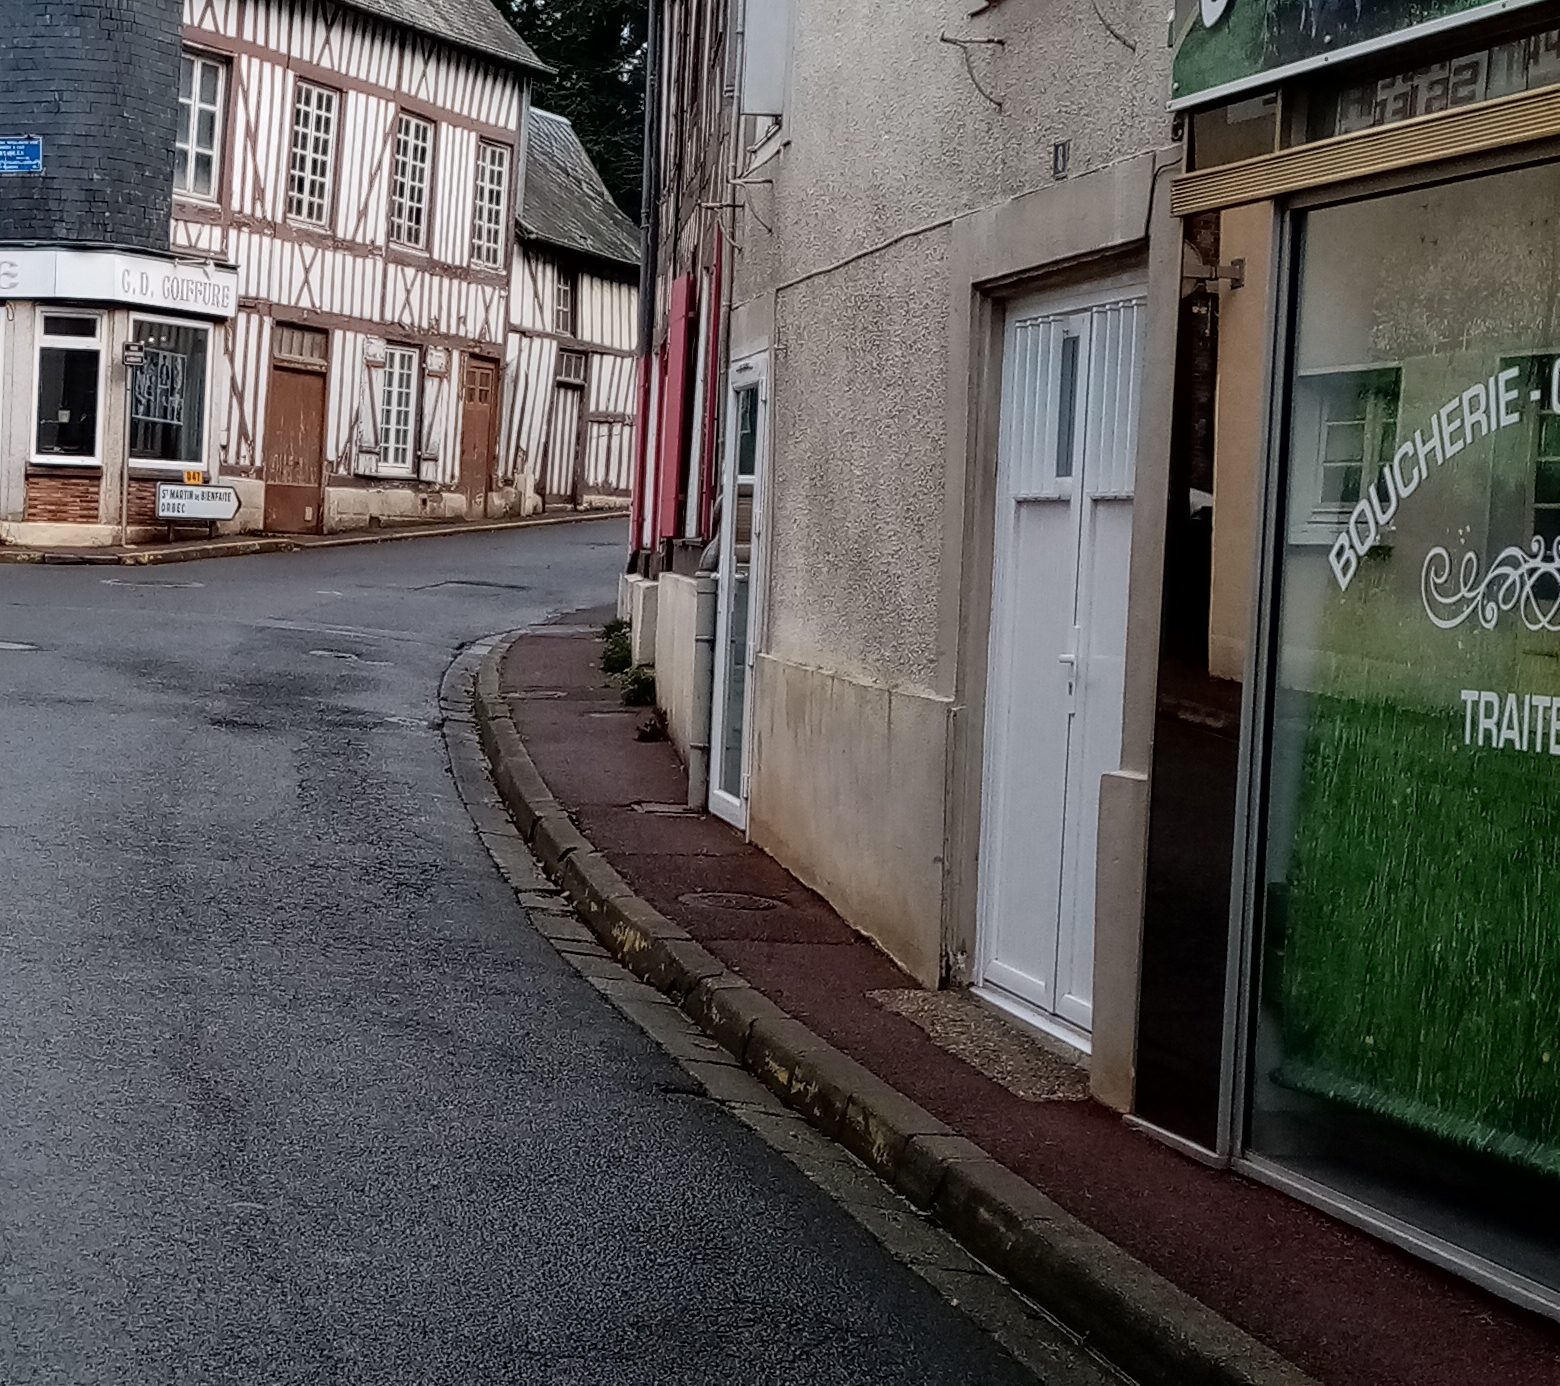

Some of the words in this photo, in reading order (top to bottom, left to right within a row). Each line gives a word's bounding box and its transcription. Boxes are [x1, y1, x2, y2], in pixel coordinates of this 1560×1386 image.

[169, 489, 194, 500] MARTIN
[200, 491, 232, 502] BIENFAITE
[1327, 365, 1521, 592] BOUCHERIE
